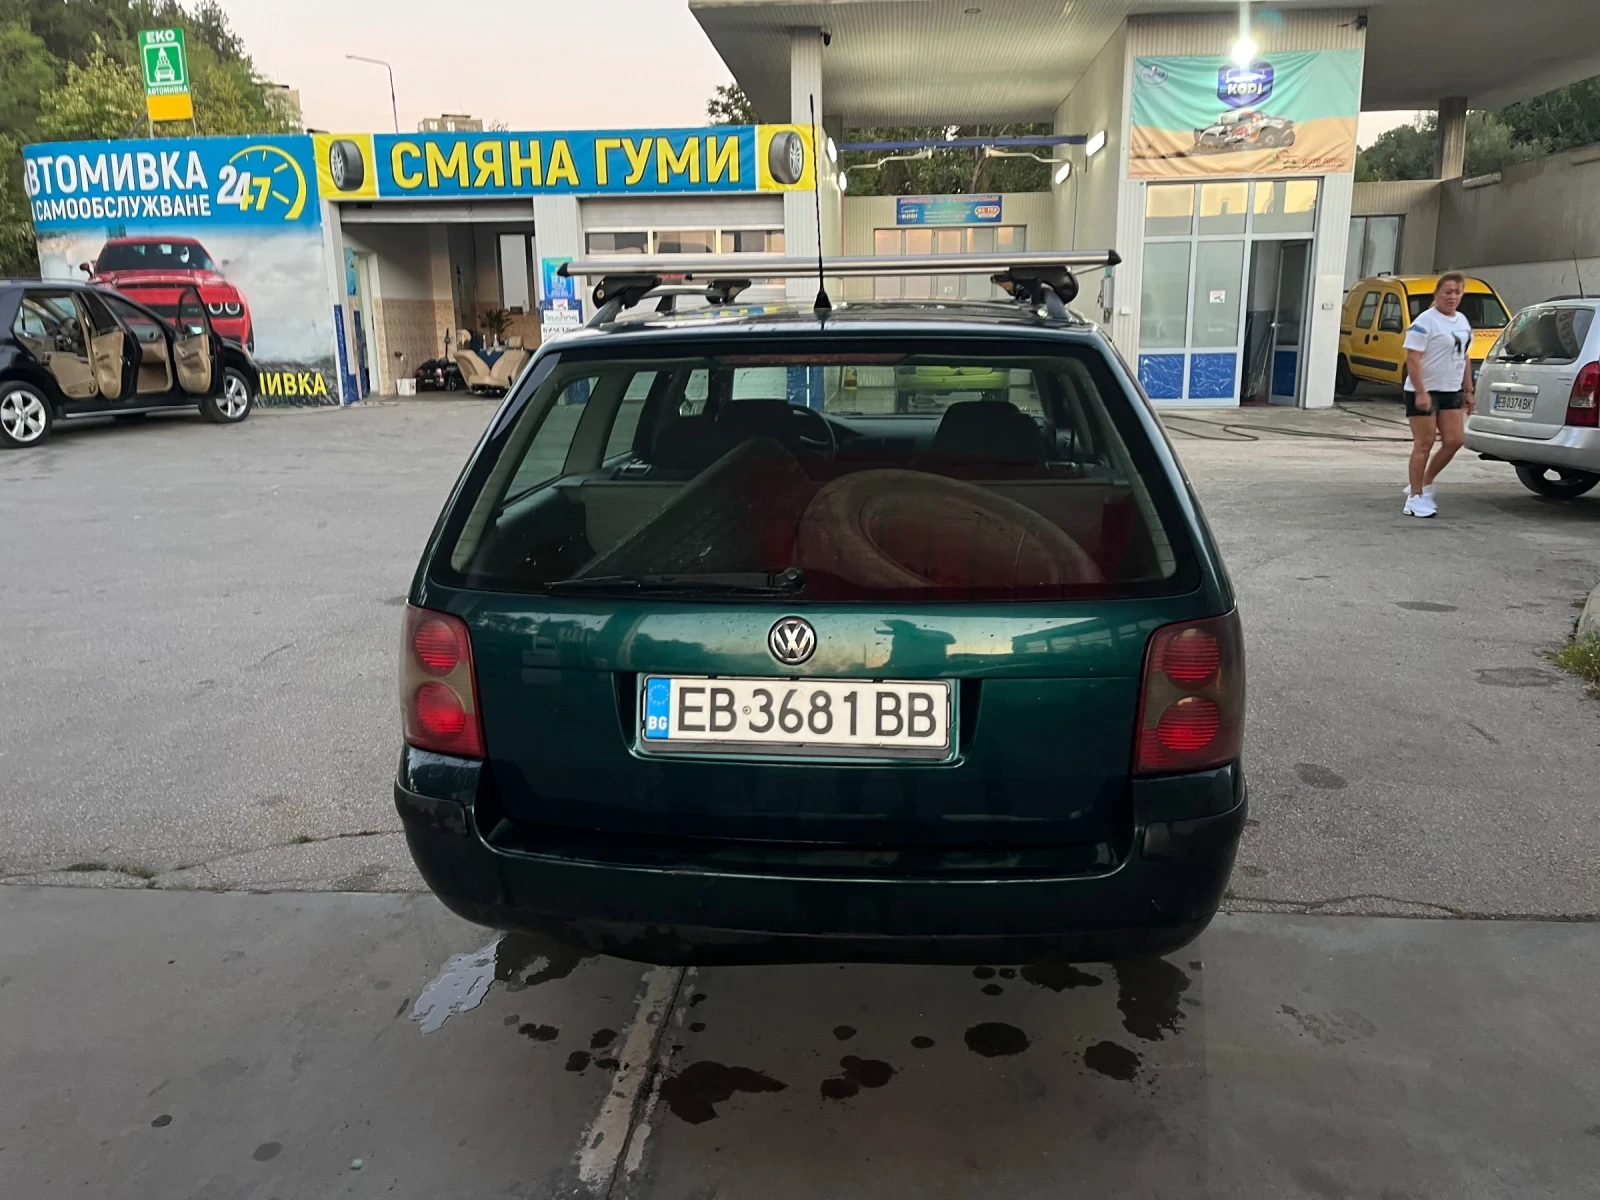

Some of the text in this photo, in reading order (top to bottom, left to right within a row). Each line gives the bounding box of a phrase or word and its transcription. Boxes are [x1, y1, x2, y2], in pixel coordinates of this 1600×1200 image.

[146, 29, 175, 43] ЕКО
[147, 85, 188, 96] АВТОМИВКА
[1227, 82, 1263, 95] KODI
[390, 135, 741, 190] СМЯНА ГУМИ
[36, 193, 212, 222] САМООБСЛУЖВАНЕ
[1507, 397, 1522, 409] 0374
[1522, 398, 1532, 411] BK
[677, 687, 937, 738] EB 3681 BB
[648, 716, 667, 731] BG
